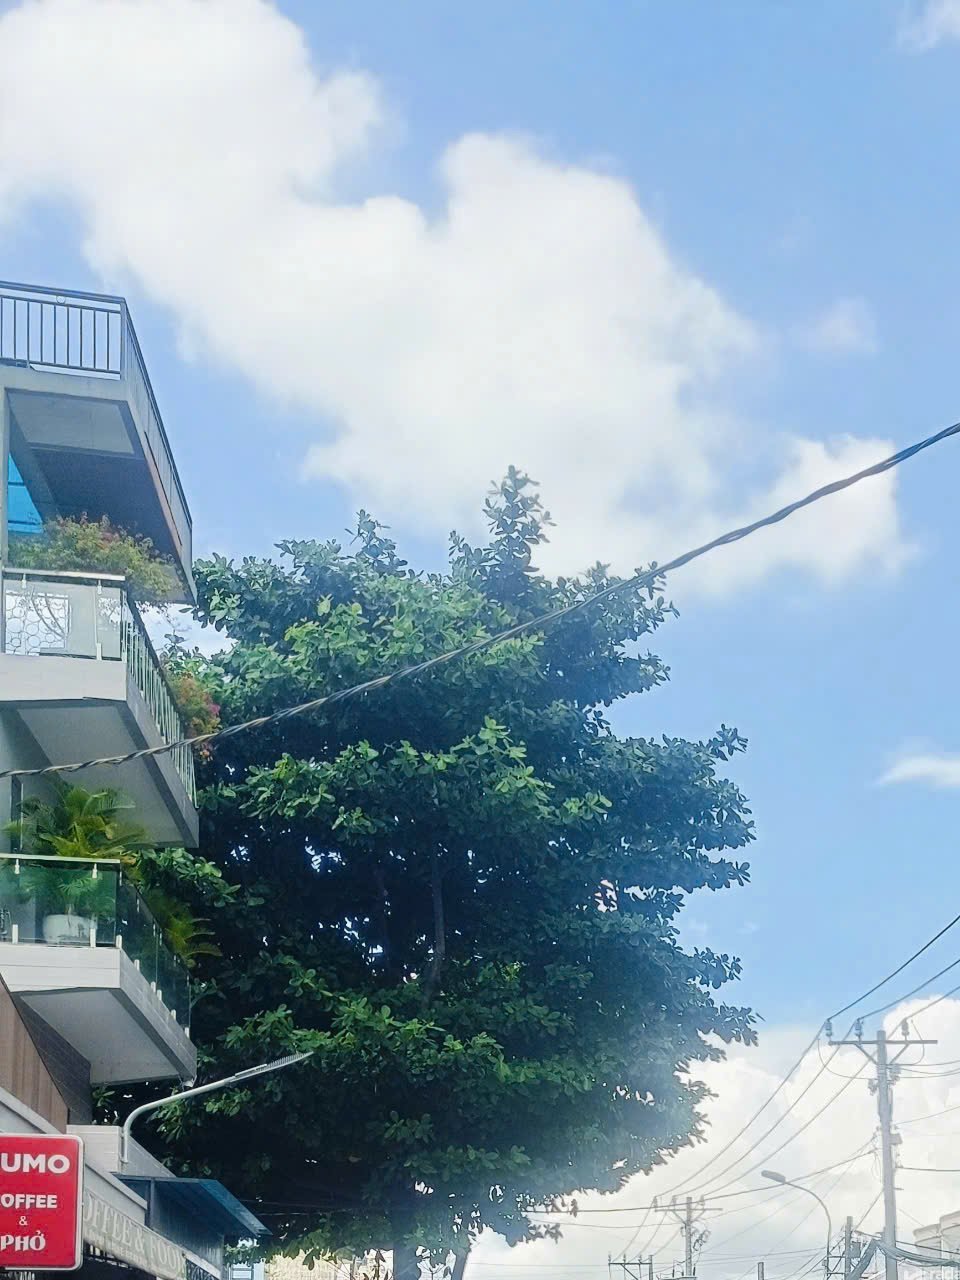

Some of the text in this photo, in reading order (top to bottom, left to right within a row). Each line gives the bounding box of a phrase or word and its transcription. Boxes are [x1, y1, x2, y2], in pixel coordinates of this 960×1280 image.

[0, 1152, 71, 1174] UMO
[0, 1193, 58, 1209] OFFEE
[18, 1215, 28, 1226] &
[1, 1230, 46, 1252] PHỞ
